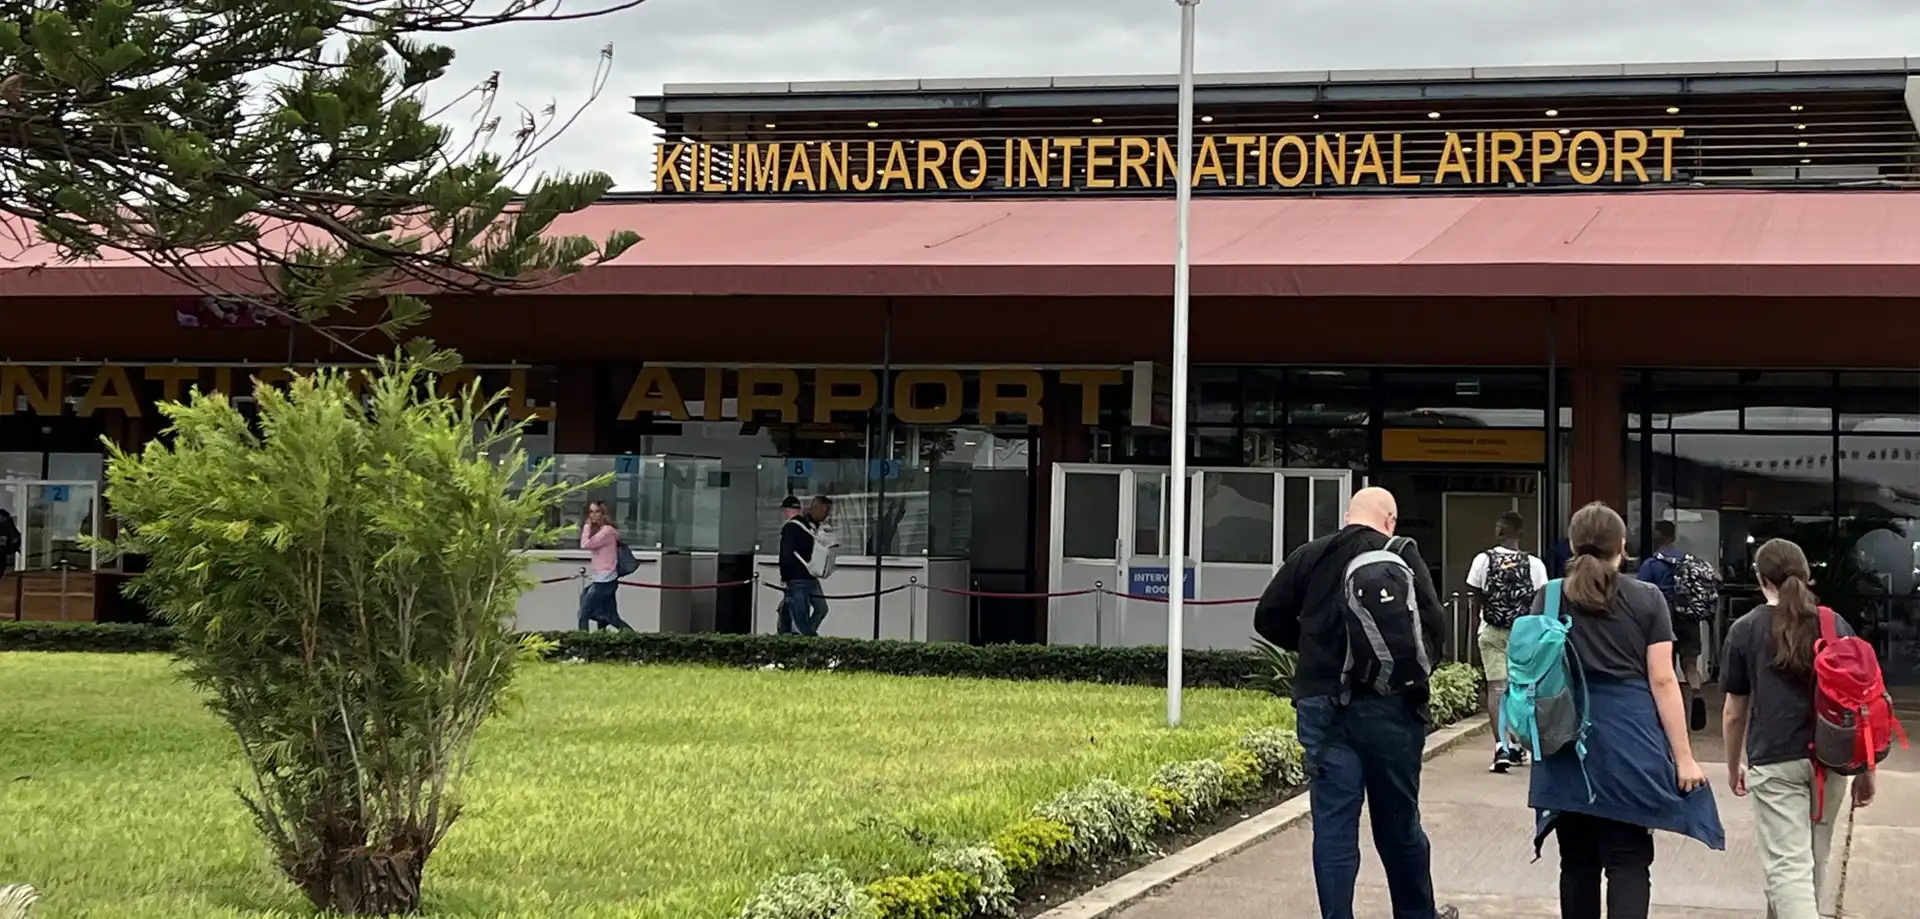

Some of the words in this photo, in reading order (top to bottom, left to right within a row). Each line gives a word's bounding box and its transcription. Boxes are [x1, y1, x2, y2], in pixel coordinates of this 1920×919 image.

[656, 139, 988, 192] KILIMANJARO
[1004, 133, 1421, 188] INTERNATIONAL
[1433, 129, 1685, 185] AIRPORT
[616, 367, 1124, 425] AIRPORT
[622, 457, 632, 473] 7
[794, 460, 804, 475] 8
[52, 486, 62, 501] 2
[1134, 573, 1188, 583] INTERV
[1145, 585, 1171, 595] ROO
